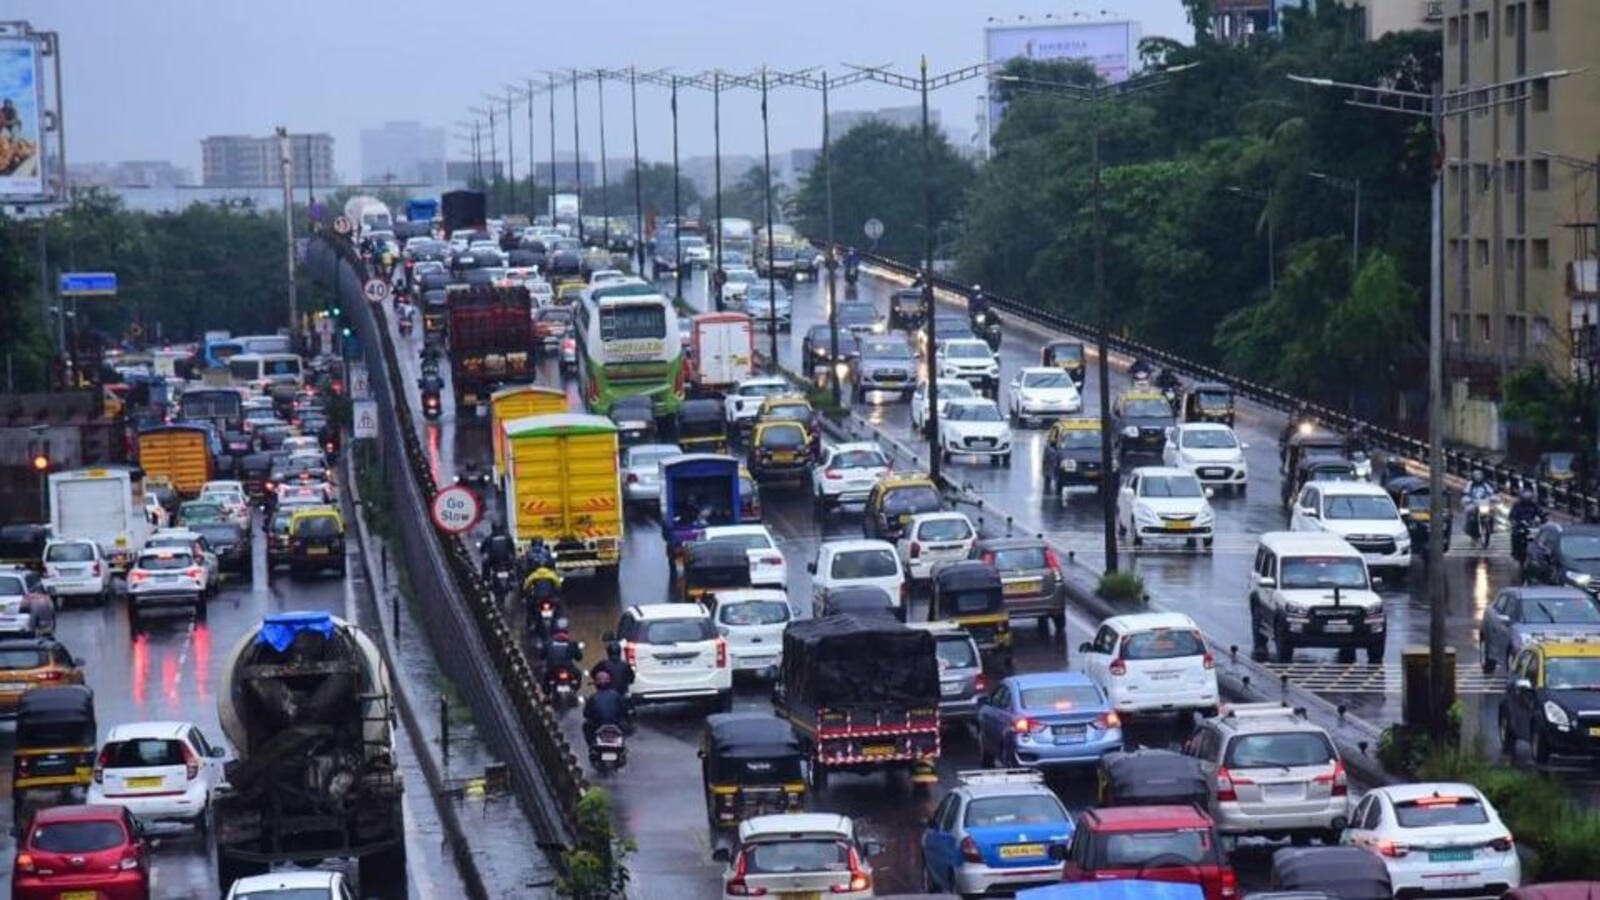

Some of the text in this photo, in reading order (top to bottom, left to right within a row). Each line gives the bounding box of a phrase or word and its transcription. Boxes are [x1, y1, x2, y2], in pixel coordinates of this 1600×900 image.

[368, 284, 384, 297] 40
[447, 497, 464, 509] Go
[440, 511, 469, 520] Slow
